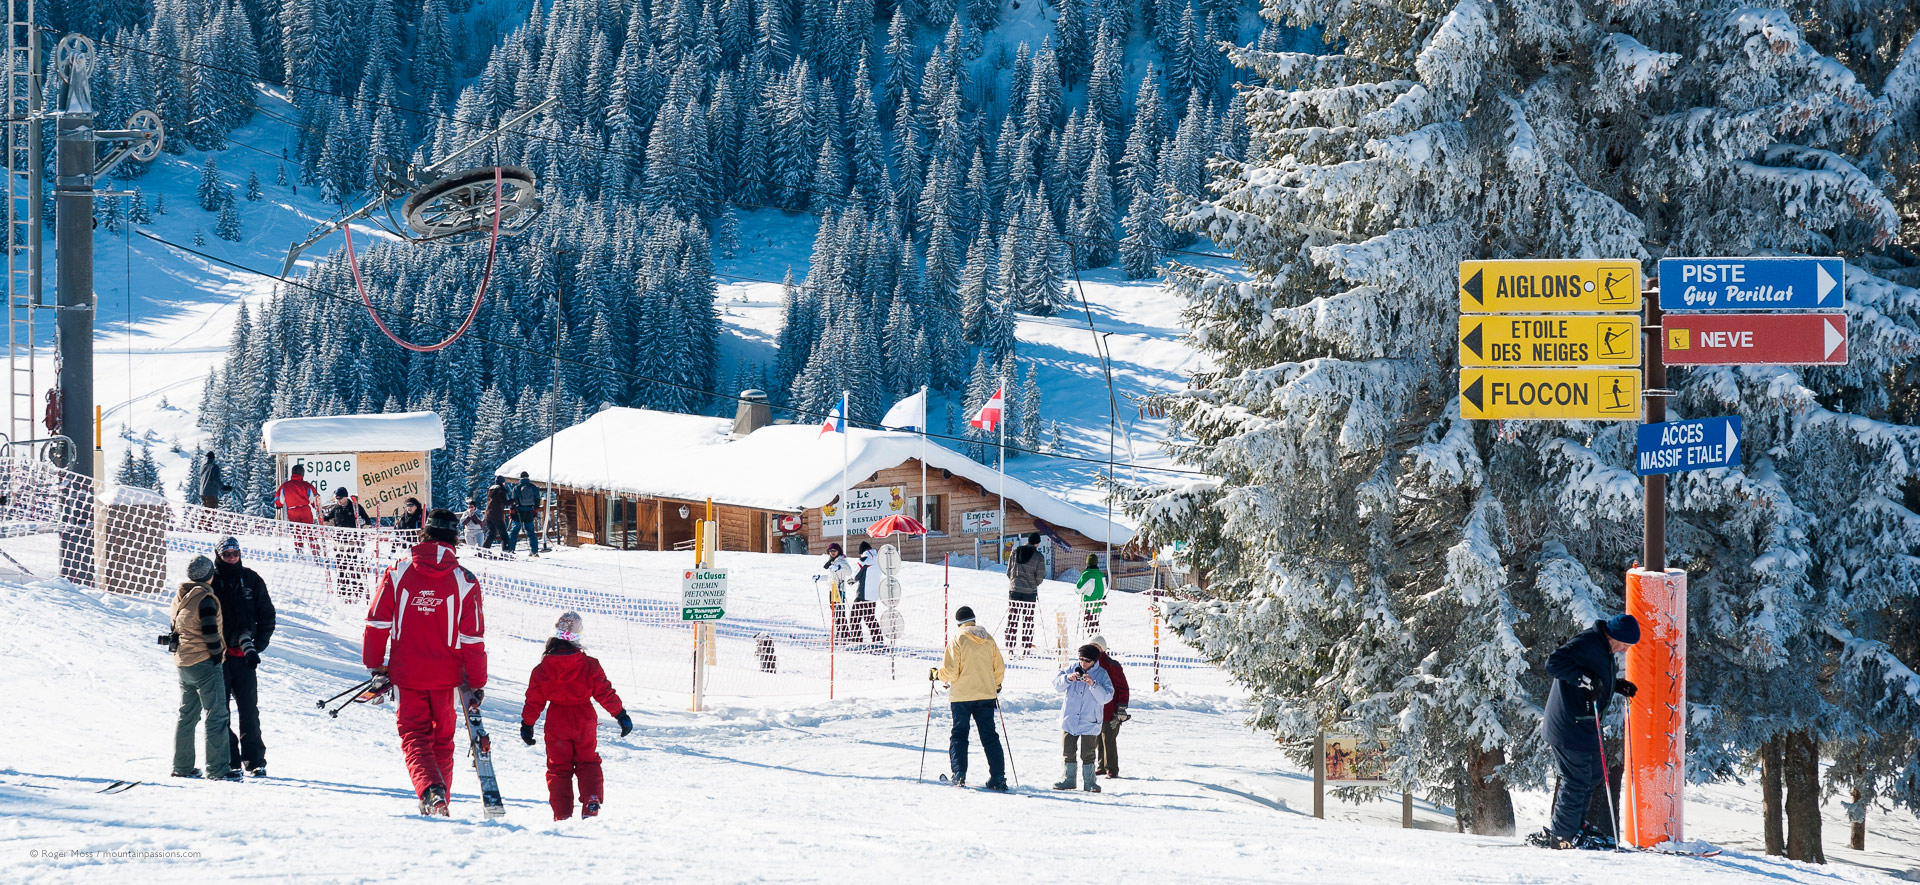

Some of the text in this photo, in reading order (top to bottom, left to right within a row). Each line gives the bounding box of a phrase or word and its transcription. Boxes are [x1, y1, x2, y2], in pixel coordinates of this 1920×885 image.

[1682, 264, 1746, 283] PISTE
[1496, 275, 1581, 298] AIGLONS
[1683, 285, 1793, 306] Guy Perillat
[1511, 320, 1568, 339] ETOILE
[1700, 331, 1754, 348] NEVE
[1491, 343, 1589, 362] DES NEIGES
[1491, 382, 1588, 406] FLOCON
[1660, 423, 1704, 447] ACCES
[297, 458, 351, 476] Espace
[1640, 444, 1723, 471] MASSIF ETALE
[362, 458, 420, 487] Bienvenue
[365, 480, 419, 509] au Grizzly
[856, 490, 870, 499] Le
[823, 518, 848, 526] PETIT
[846, 528, 867, 536] BOISS
